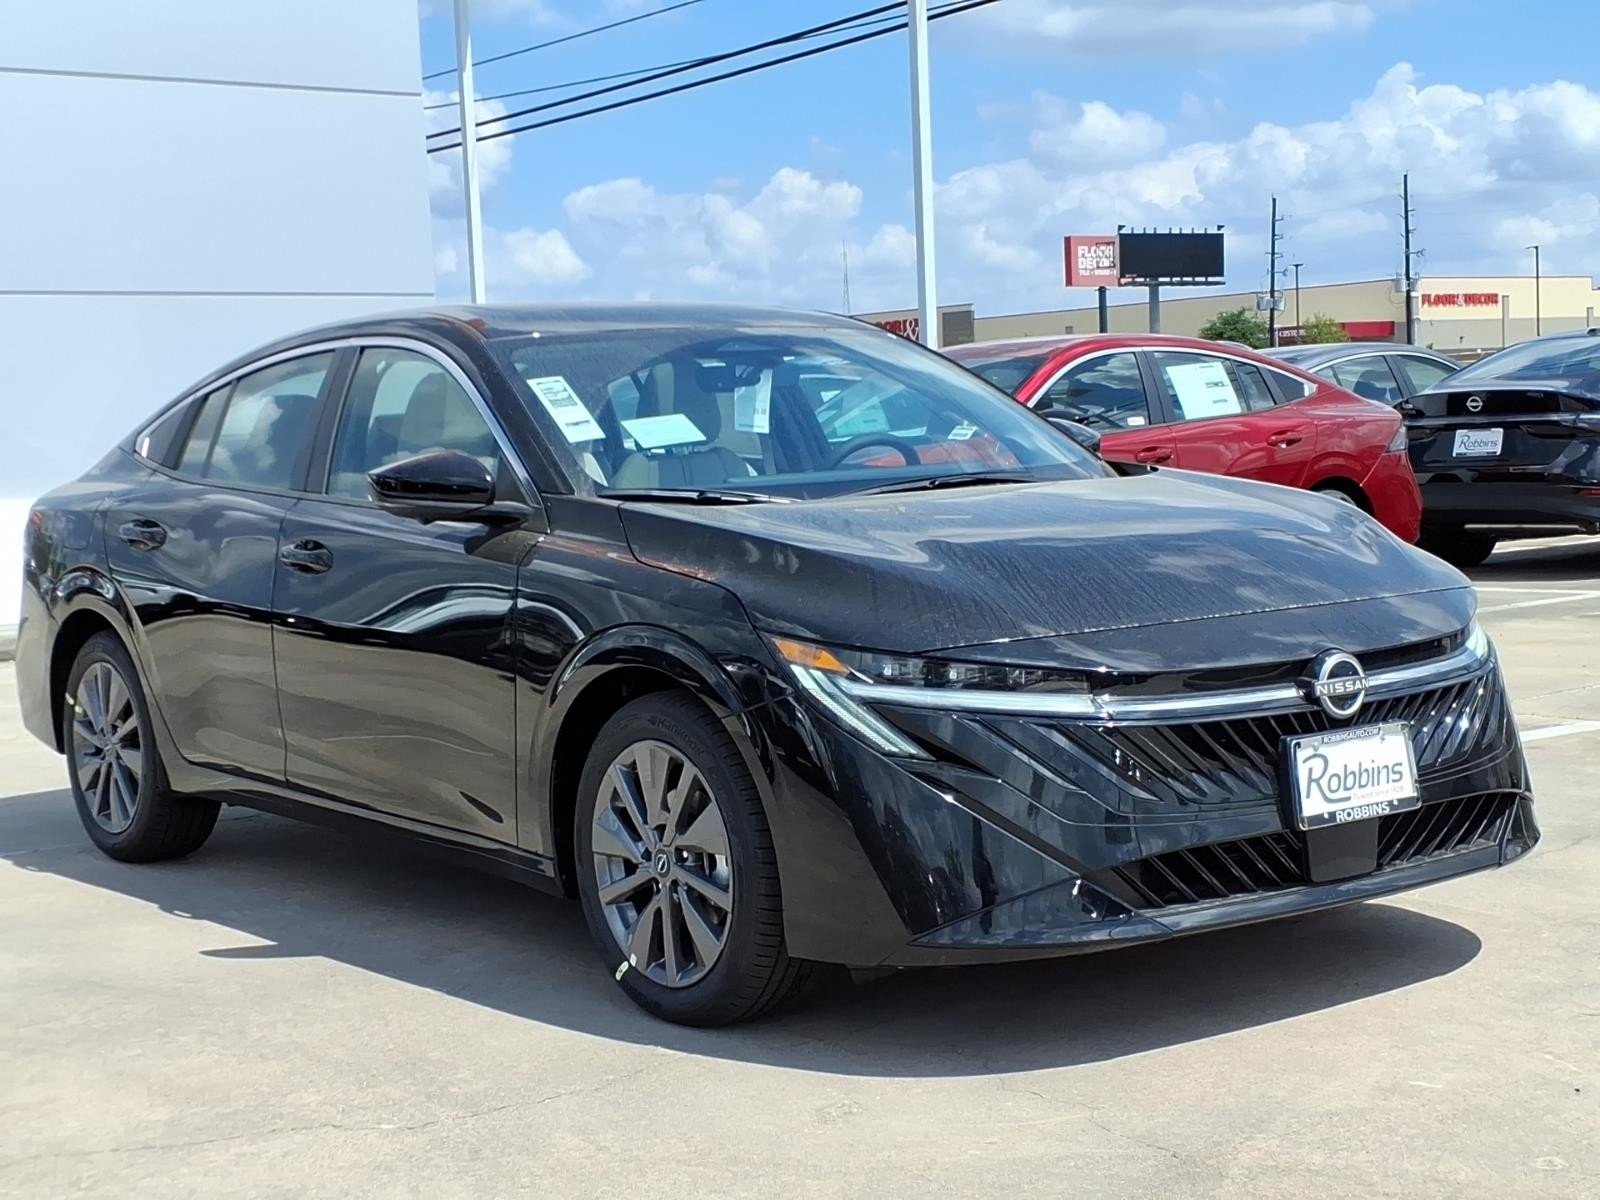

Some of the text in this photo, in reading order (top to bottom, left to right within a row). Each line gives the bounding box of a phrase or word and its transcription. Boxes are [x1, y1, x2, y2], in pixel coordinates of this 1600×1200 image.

[1458, 434, 1499, 450] Robbins
[1316, 679, 1369, 695] NISSAN
[1302, 752, 1403, 804] Robbins
[1335, 801, 1390, 823] ROBBINS
